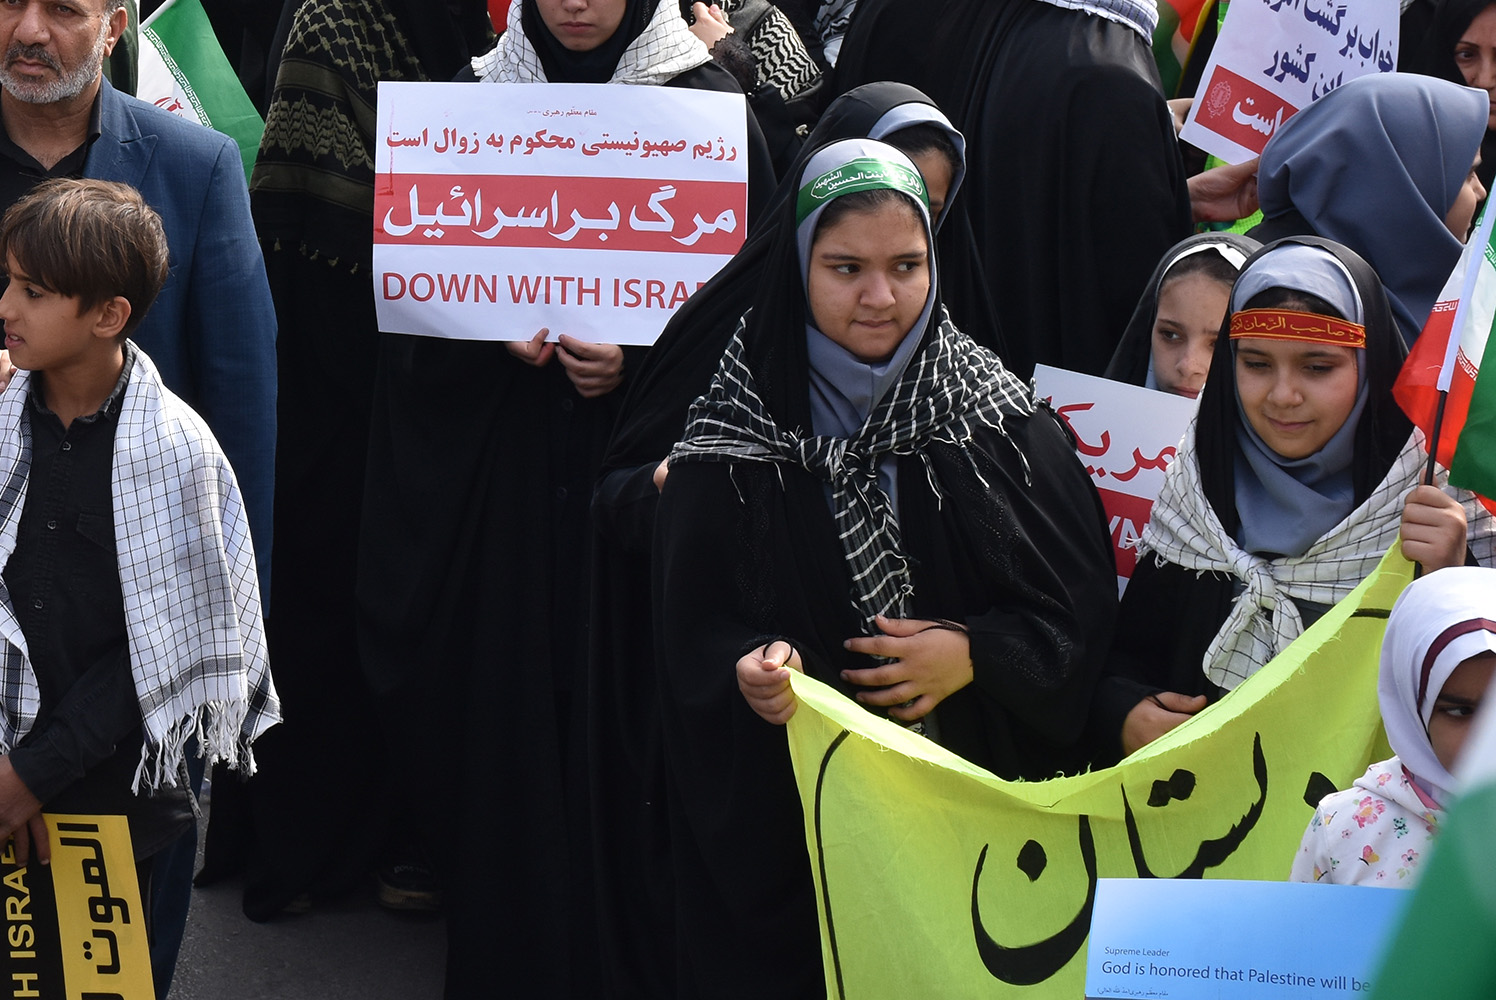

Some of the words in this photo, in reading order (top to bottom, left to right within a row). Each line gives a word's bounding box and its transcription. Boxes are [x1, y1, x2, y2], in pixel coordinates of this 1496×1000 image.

[1263, 43, 1316, 84] کشور
[386, 127, 429, 149] است
[434, 128, 479, 155] زوال
[486, 131, 504, 151] به
[509, 129, 575, 155] محکوم
[581, 130, 687, 158] صهیونیستی
[692, 136, 737, 162] رژیم
[382, 184, 558, 240] اسرائیل
[629, 185, 738, 246] مرگ
[382, 272, 497, 305] DOWN
[507, 276, 602, 308] WITH
[1290, 322, 1345, 338] صاحب
[57, 821, 130, 975] الموت
[1104, 947, 1141, 957] Supreme
[1142, 948, 1170, 957] Leader
[1102, 961, 1131, 975] God
[1135, 962, 1146, 976] is
[1149, 963, 1210, 979] honored
[1214, 967, 1244, 982] that
[1248, 968, 1316, 988] Palestine
[1320, 976, 1347, 991] will
[1351, 977, 1371, 992] be
